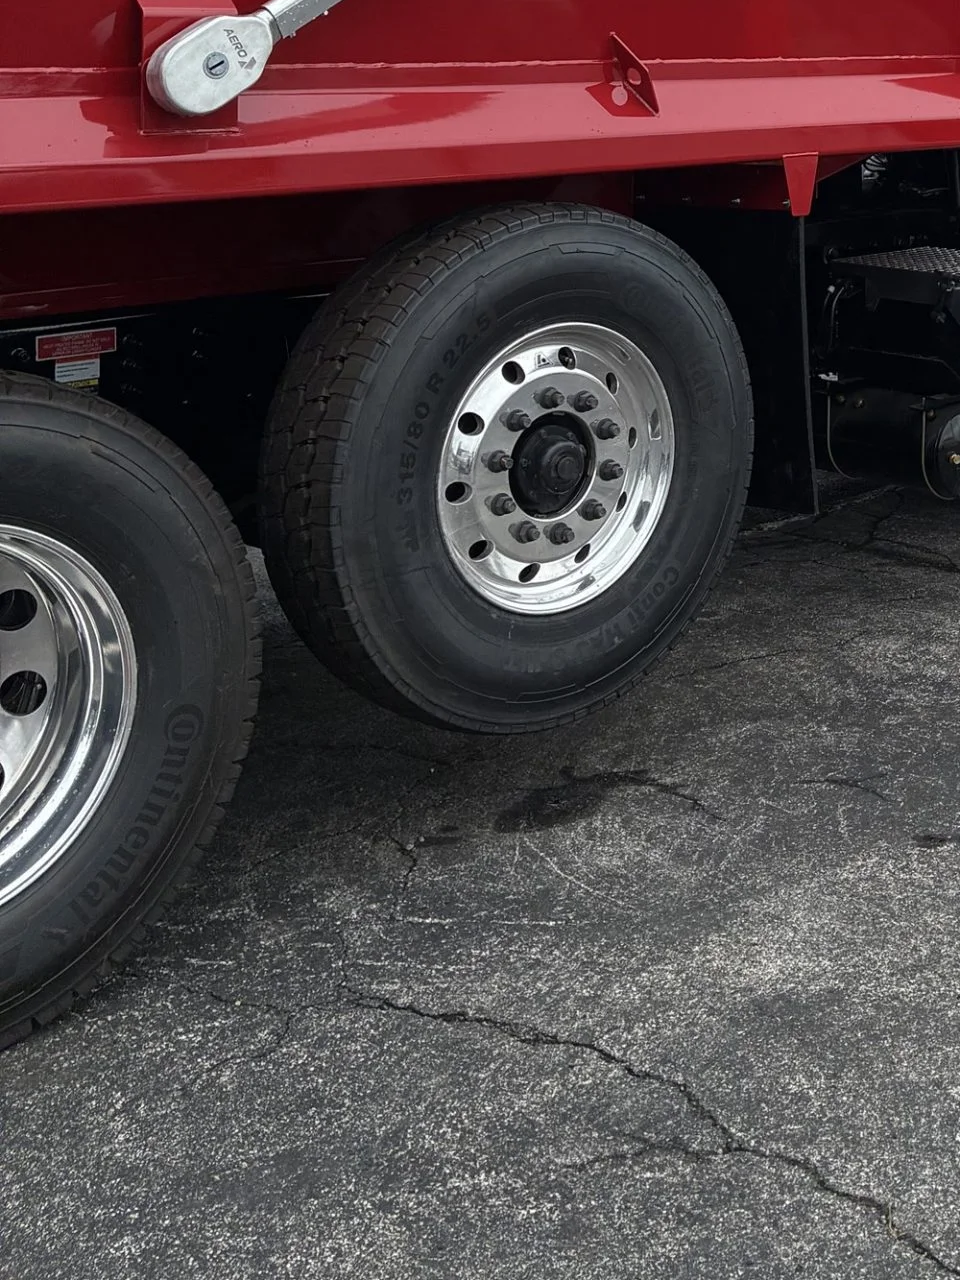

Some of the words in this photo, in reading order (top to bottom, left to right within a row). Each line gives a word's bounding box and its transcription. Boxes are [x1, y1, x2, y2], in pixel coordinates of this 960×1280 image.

[223, 28, 248, 58] AERO
[397, 402, 430, 505] 315/80
[426, 372, 444, 394] R
[443, 313, 490, 366] 22.5
[62, 703, 205, 924] Continental
